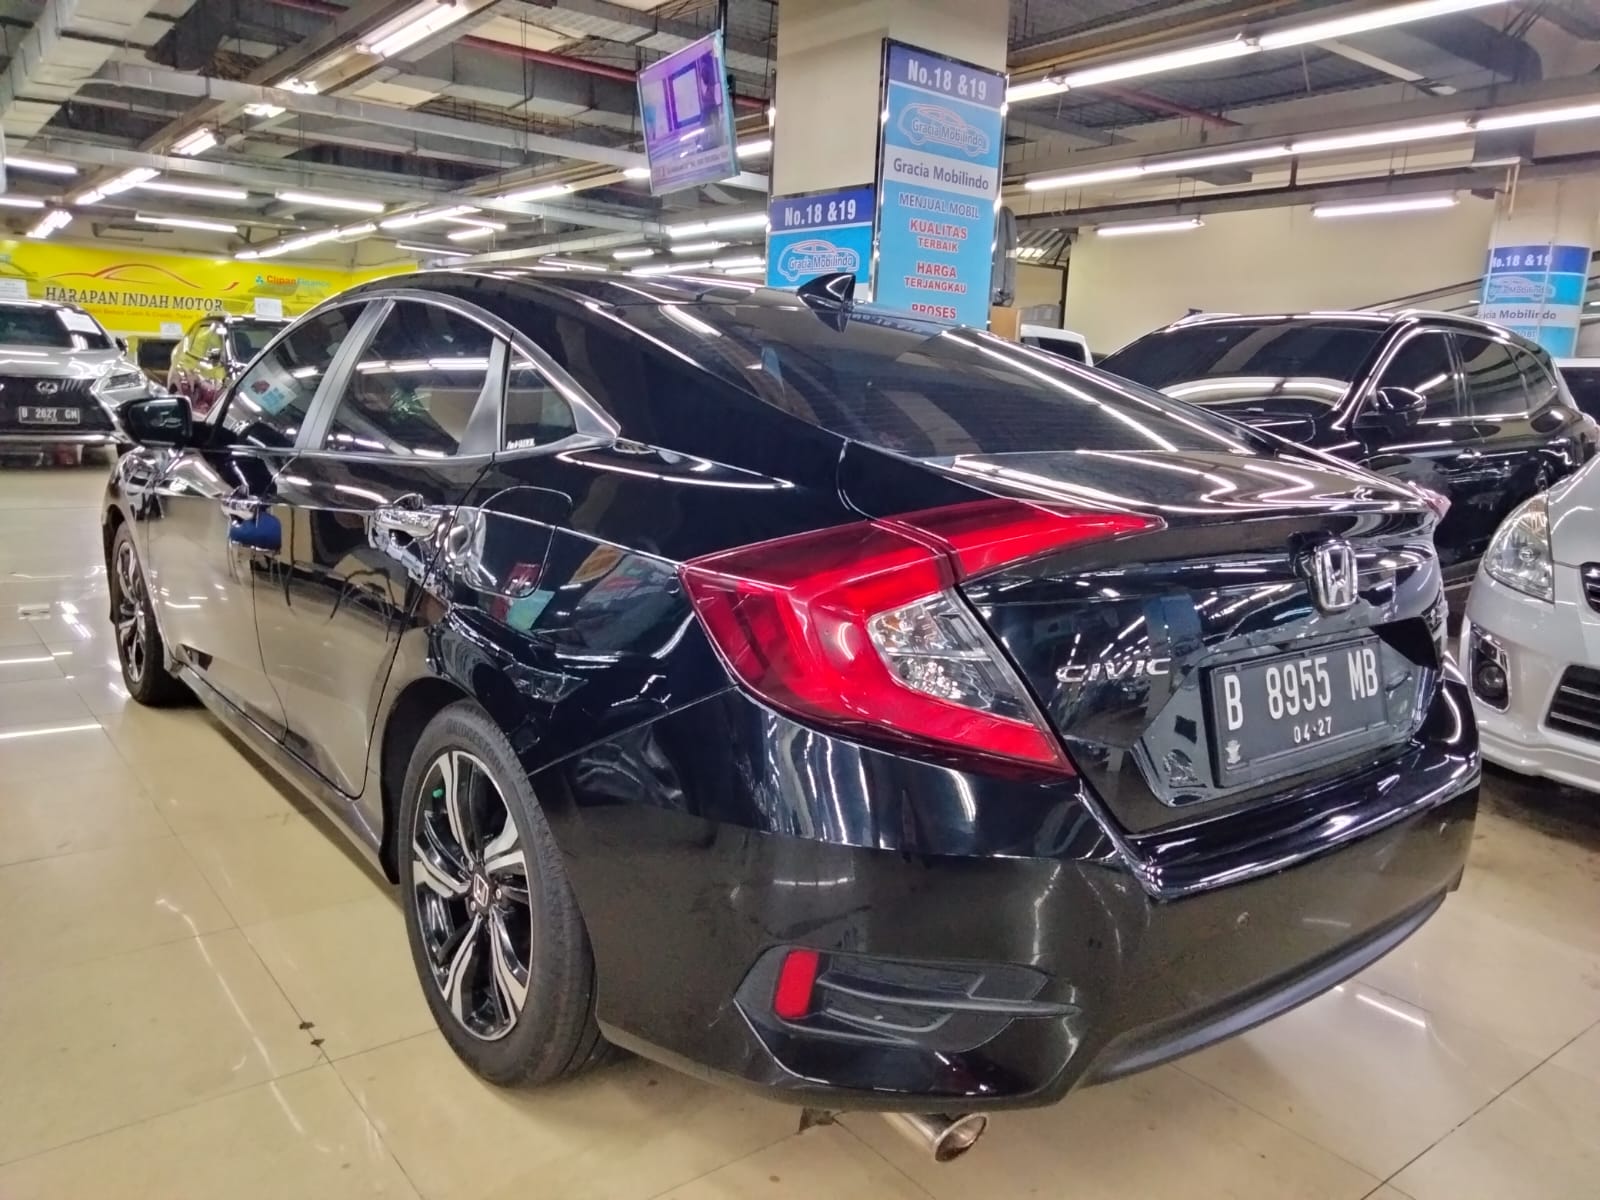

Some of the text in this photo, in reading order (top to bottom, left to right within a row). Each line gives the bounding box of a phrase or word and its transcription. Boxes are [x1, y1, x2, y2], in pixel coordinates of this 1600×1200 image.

[908, 59, 987, 101] No.18 &19
[893, 158, 989, 190] Gracia Mobilindo
[784, 199, 856, 226] No.18 &19
[899, 193, 980, 218] MENJUAL MOBIL
[910, 219, 967, 239] KUALITAS
[918, 238, 958, 252] TERBAIK
[917, 262, 957, 278] HARGA
[904, 277, 967, 294] TERJANGKAU
[45, 286, 119, 306] HARAPAN
[122, 292, 169, 309] INDAH
[172, 296, 223, 312] MOTOR
[912, 303, 957, 319] PROSES
[1056, 658, 1171, 682] CIVIC
[1224, 648, 1379, 731] B 8955 MB
